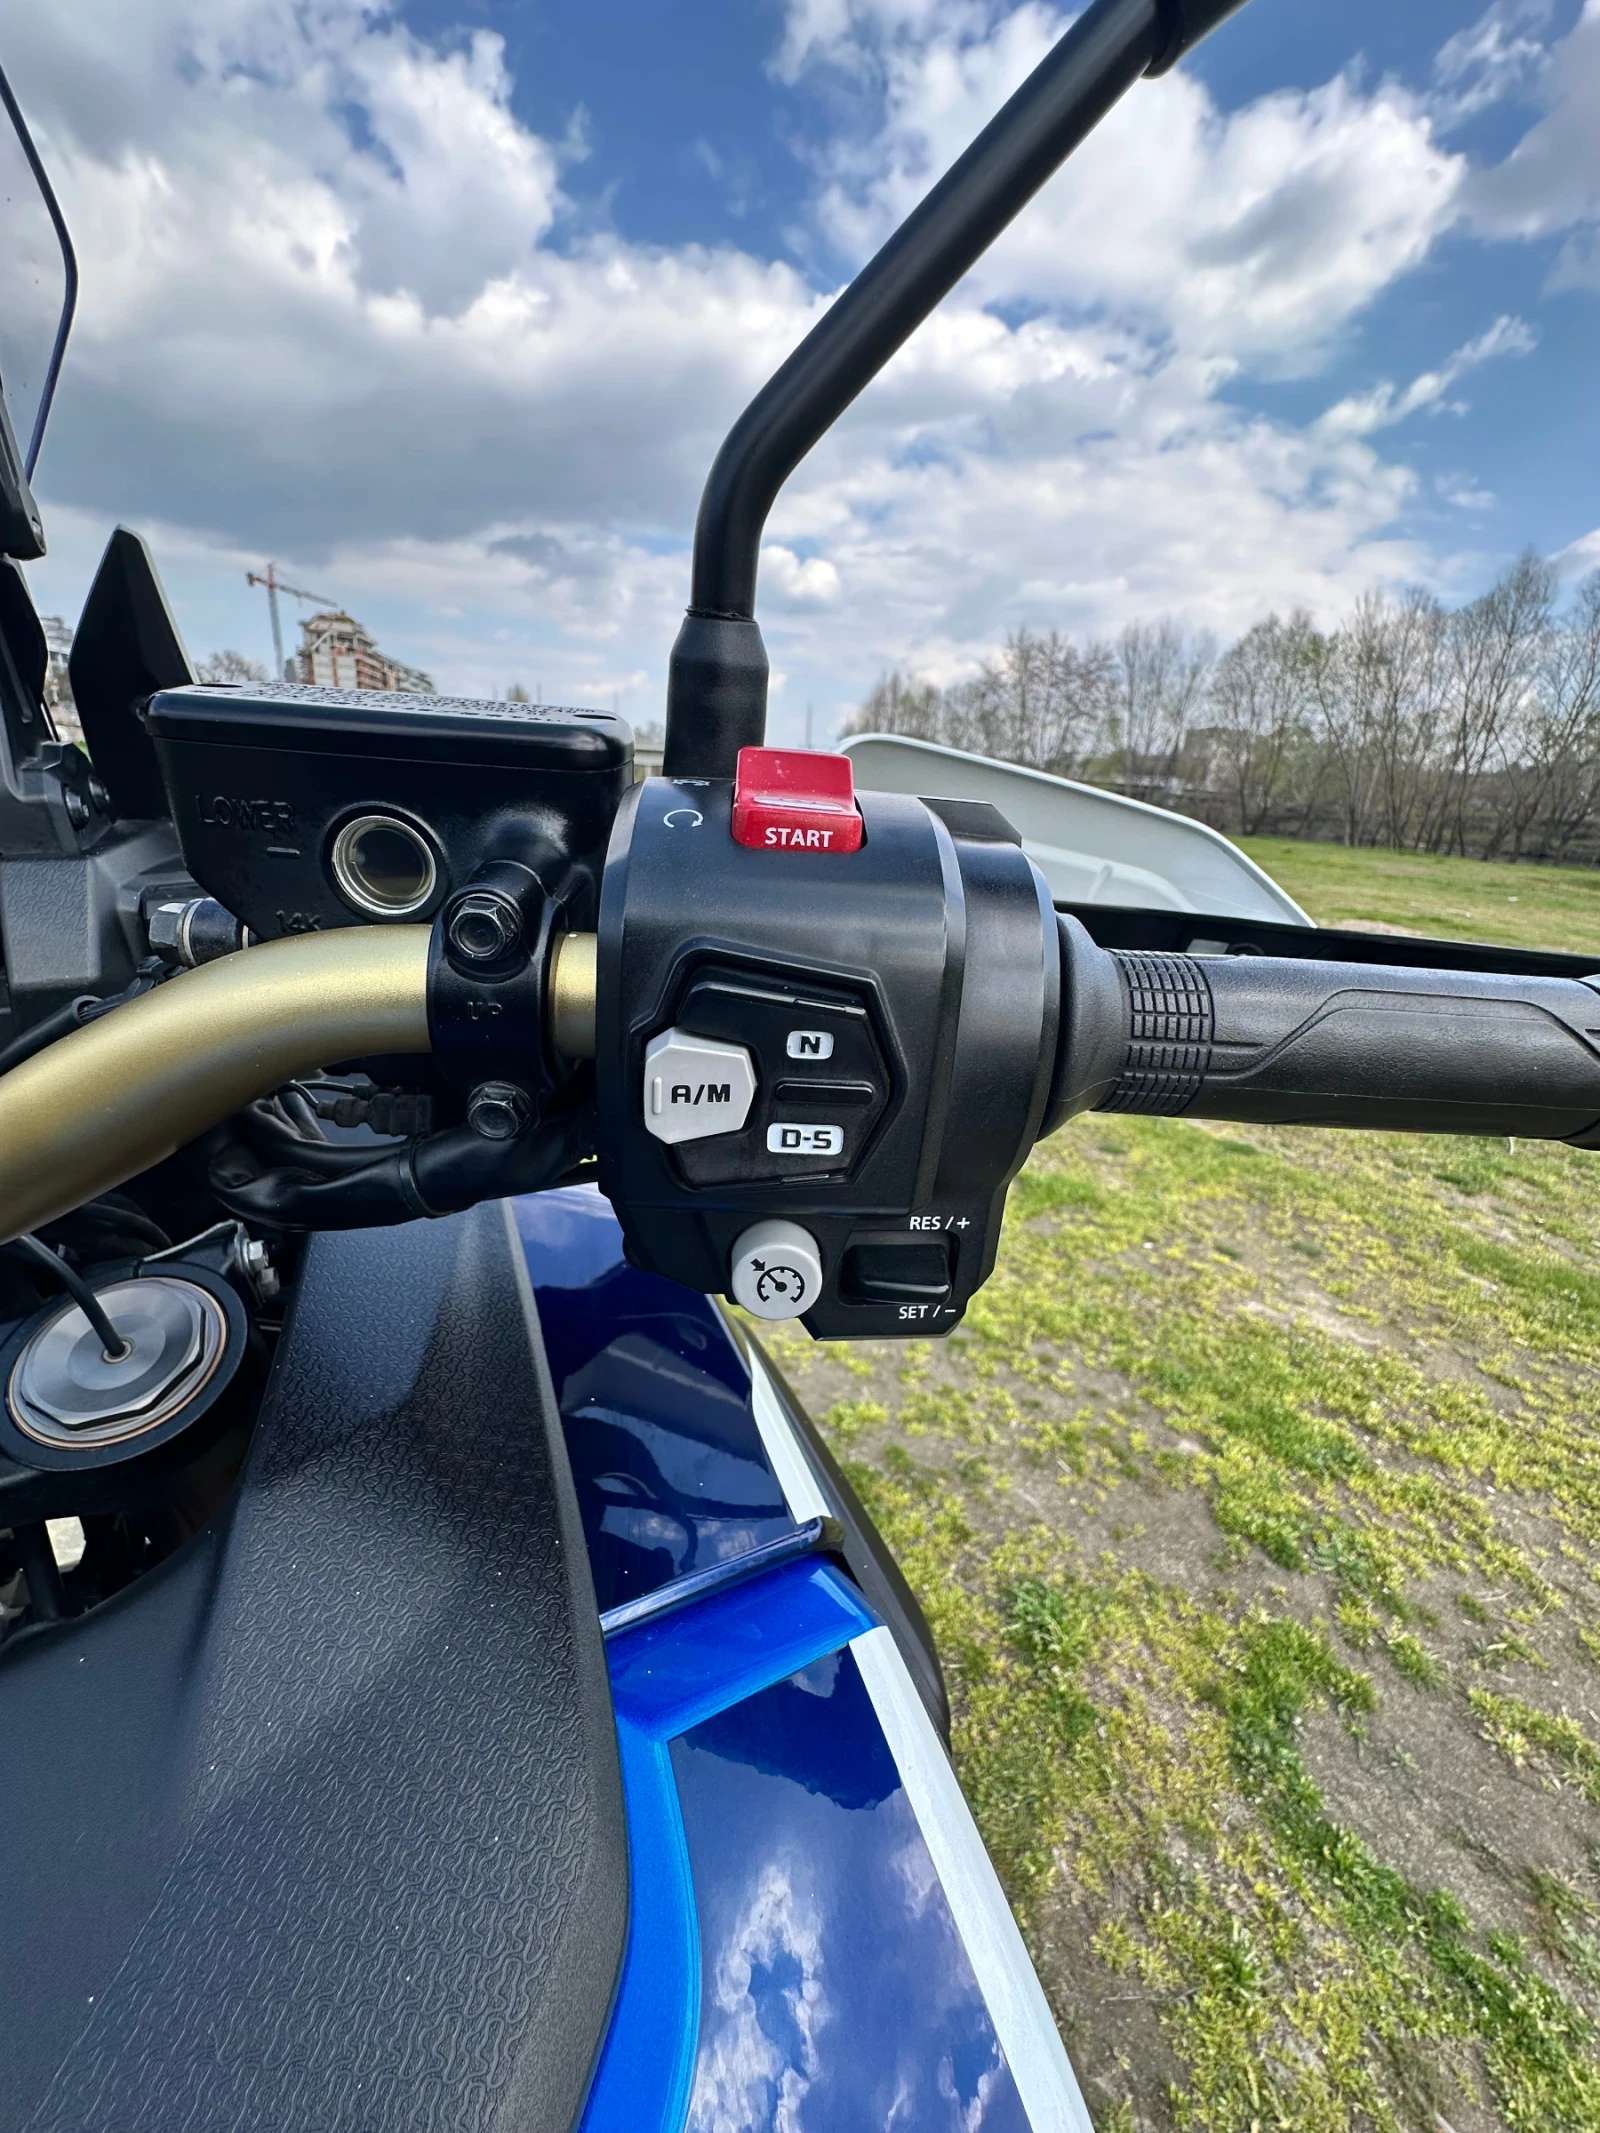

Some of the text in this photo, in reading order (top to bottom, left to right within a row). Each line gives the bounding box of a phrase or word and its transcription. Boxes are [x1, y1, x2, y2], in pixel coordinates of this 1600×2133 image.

[196, 794, 297, 831] LOWER
[764, 827, 834, 848] START
[468, 1000, 504, 1021] UP
[800, 1035, 822, 1054] N
[671, 1083, 731, 1105] A/M
[781, 1128, 832, 1149] D-S
[909, 1216, 941, 1230] RES
[899, 1305, 928, 1319] SET
